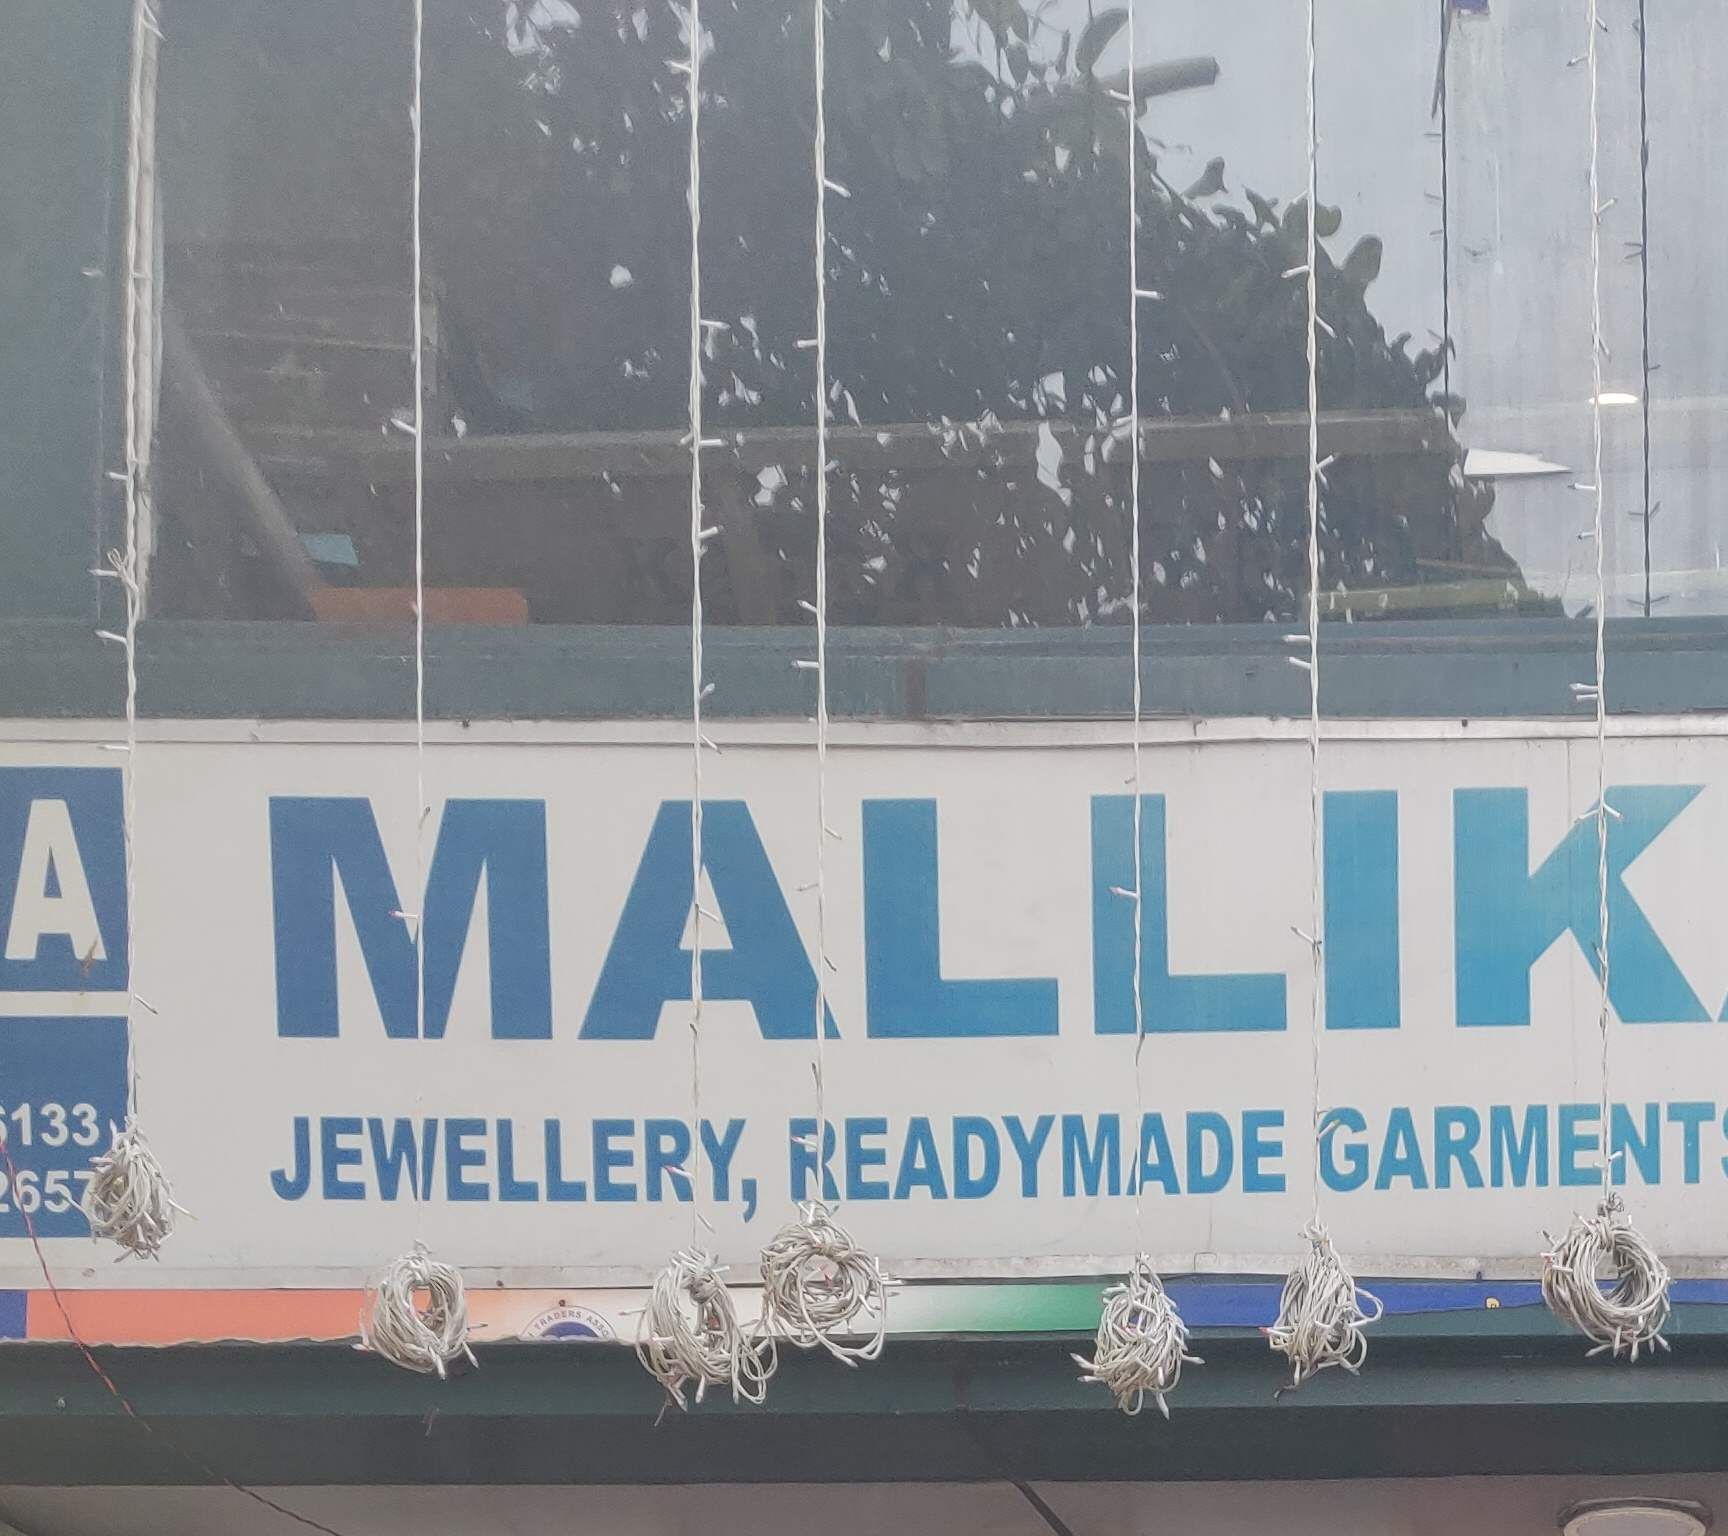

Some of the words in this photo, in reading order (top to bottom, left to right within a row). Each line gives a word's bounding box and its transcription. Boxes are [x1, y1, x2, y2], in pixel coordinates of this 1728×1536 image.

[0, 1103, 100, 1147] 133
[270, 1116, 759, 1222] JEWELLERY,
[788, 1110, 1287, 1203] READYMADE
[533, 1310, 583, 1330] TRADERS
